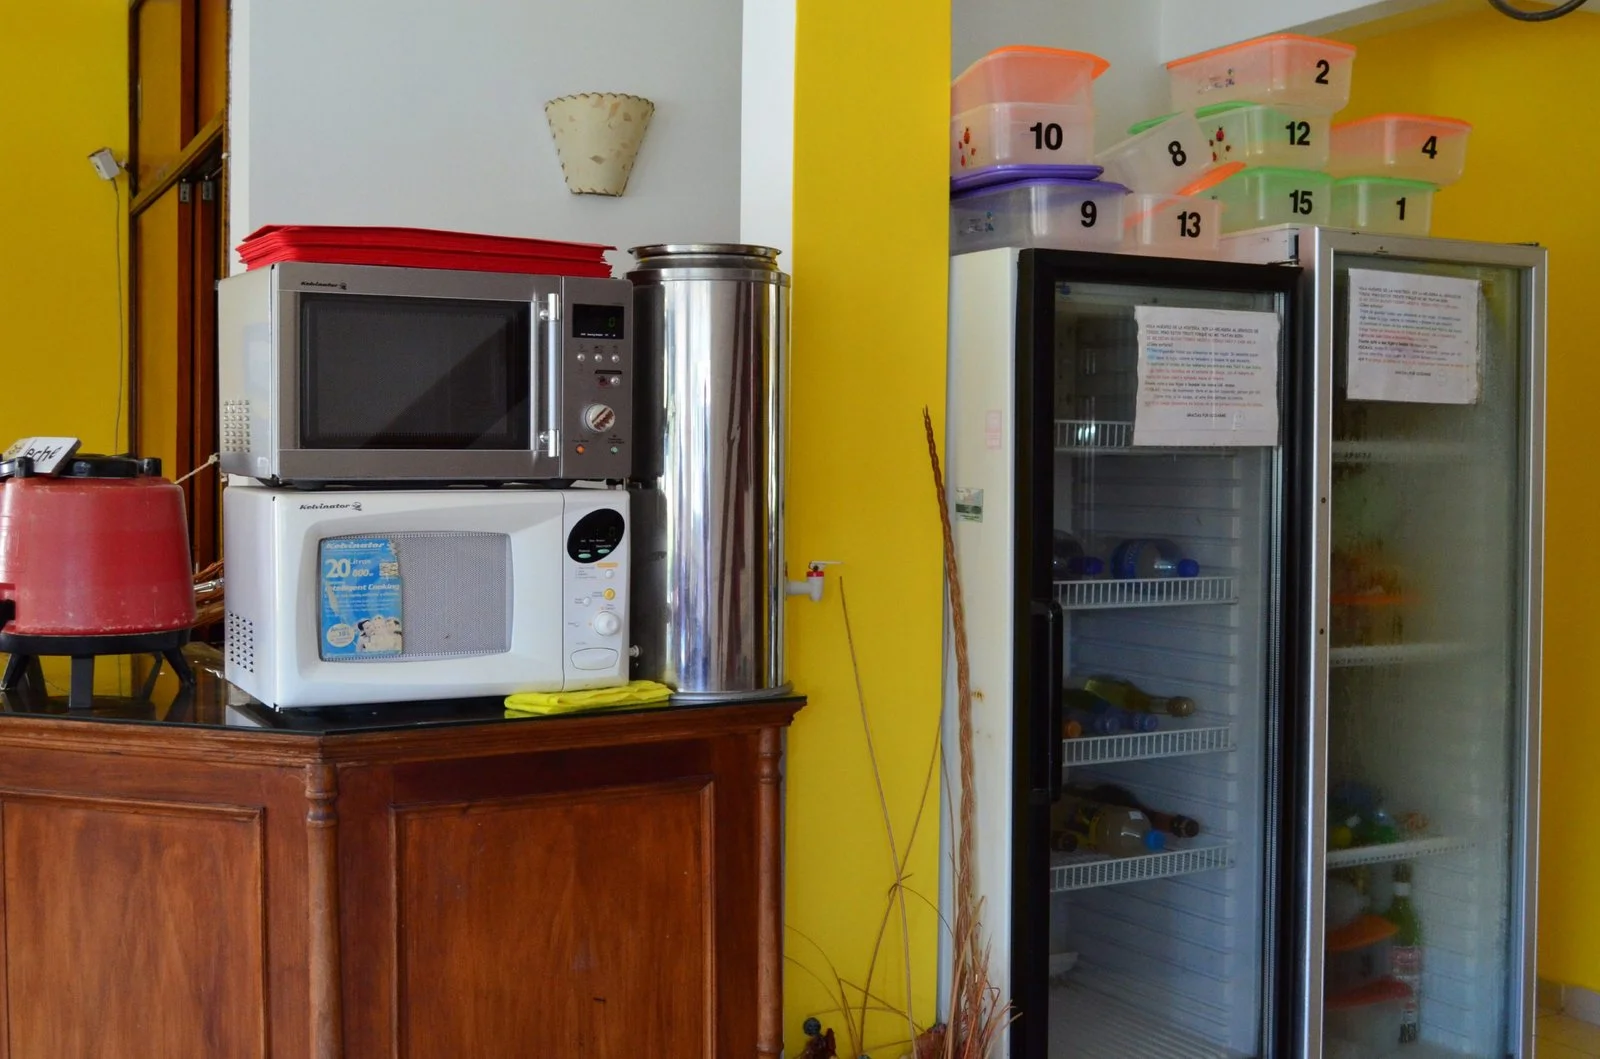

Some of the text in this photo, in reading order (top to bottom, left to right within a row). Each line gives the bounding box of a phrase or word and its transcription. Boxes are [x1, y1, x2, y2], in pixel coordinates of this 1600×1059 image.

[1314, 58, 1330, 85] 2
[1029, 121, 1064, 151] 10
[1284, 120, 1311, 147] 12
[1167, 140, 1187, 167] 8
[1421, 135, 1438, 160] 4
[1080, 200, 1098, 229] 9
[1288, 189, 1313, 216] 15
[1395, 196, 1407, 222] 1
[1176, 210, 1202, 239] 13
[299, 502, 351, 510] Kelvinator
[326, 541, 385, 550] Kelvinator
[325, 558, 351, 579] 20
